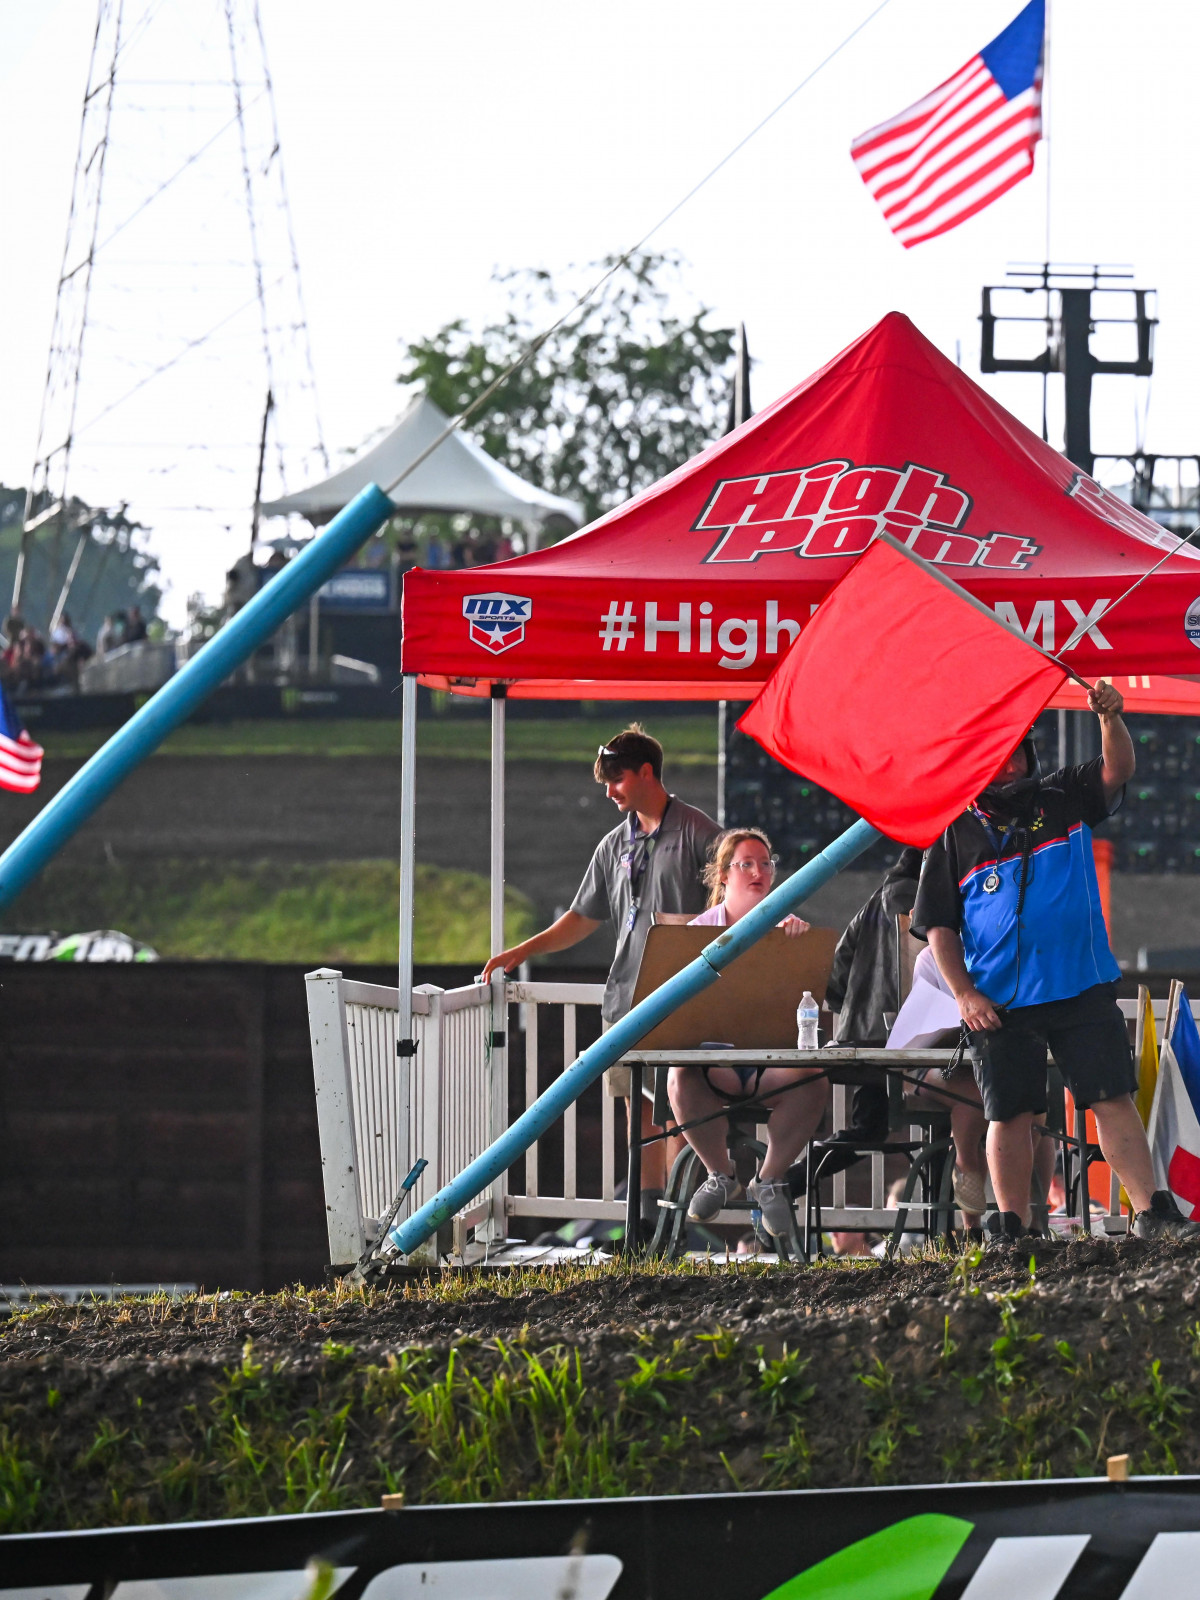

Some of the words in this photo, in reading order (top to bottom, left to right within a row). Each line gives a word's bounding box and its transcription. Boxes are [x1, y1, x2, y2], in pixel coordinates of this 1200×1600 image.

[691, 461, 973, 531] High
[701, 509, 1042, 570] Point
[465, 599, 530, 615] MX
